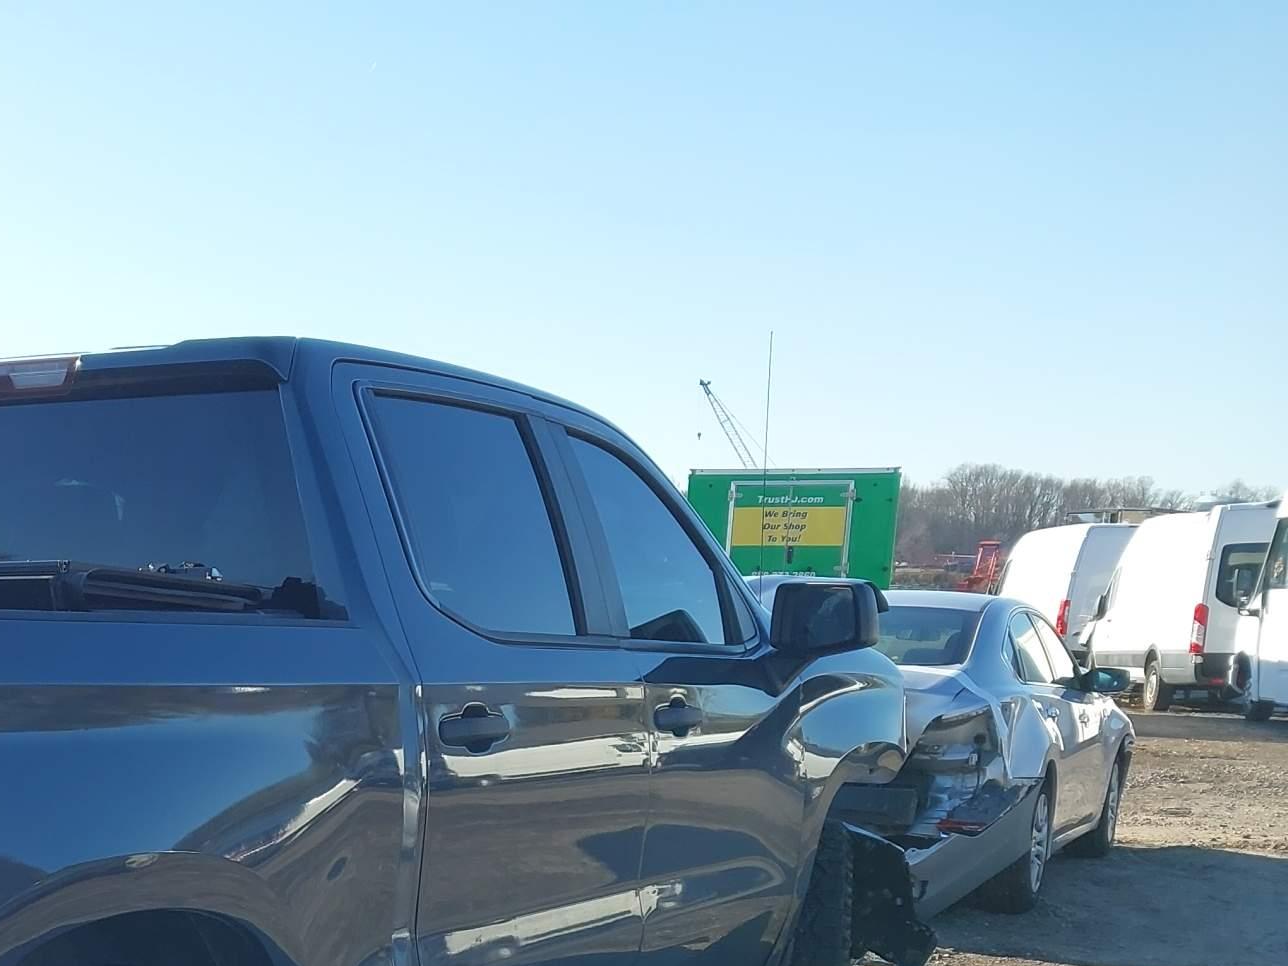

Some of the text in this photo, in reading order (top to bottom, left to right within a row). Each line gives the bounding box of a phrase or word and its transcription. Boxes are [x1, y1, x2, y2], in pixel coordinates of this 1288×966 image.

[765, 509, 808, 520] We Bring
[763, 521, 807, 532] Our Shop
[767, 534, 802, 543] To You!
